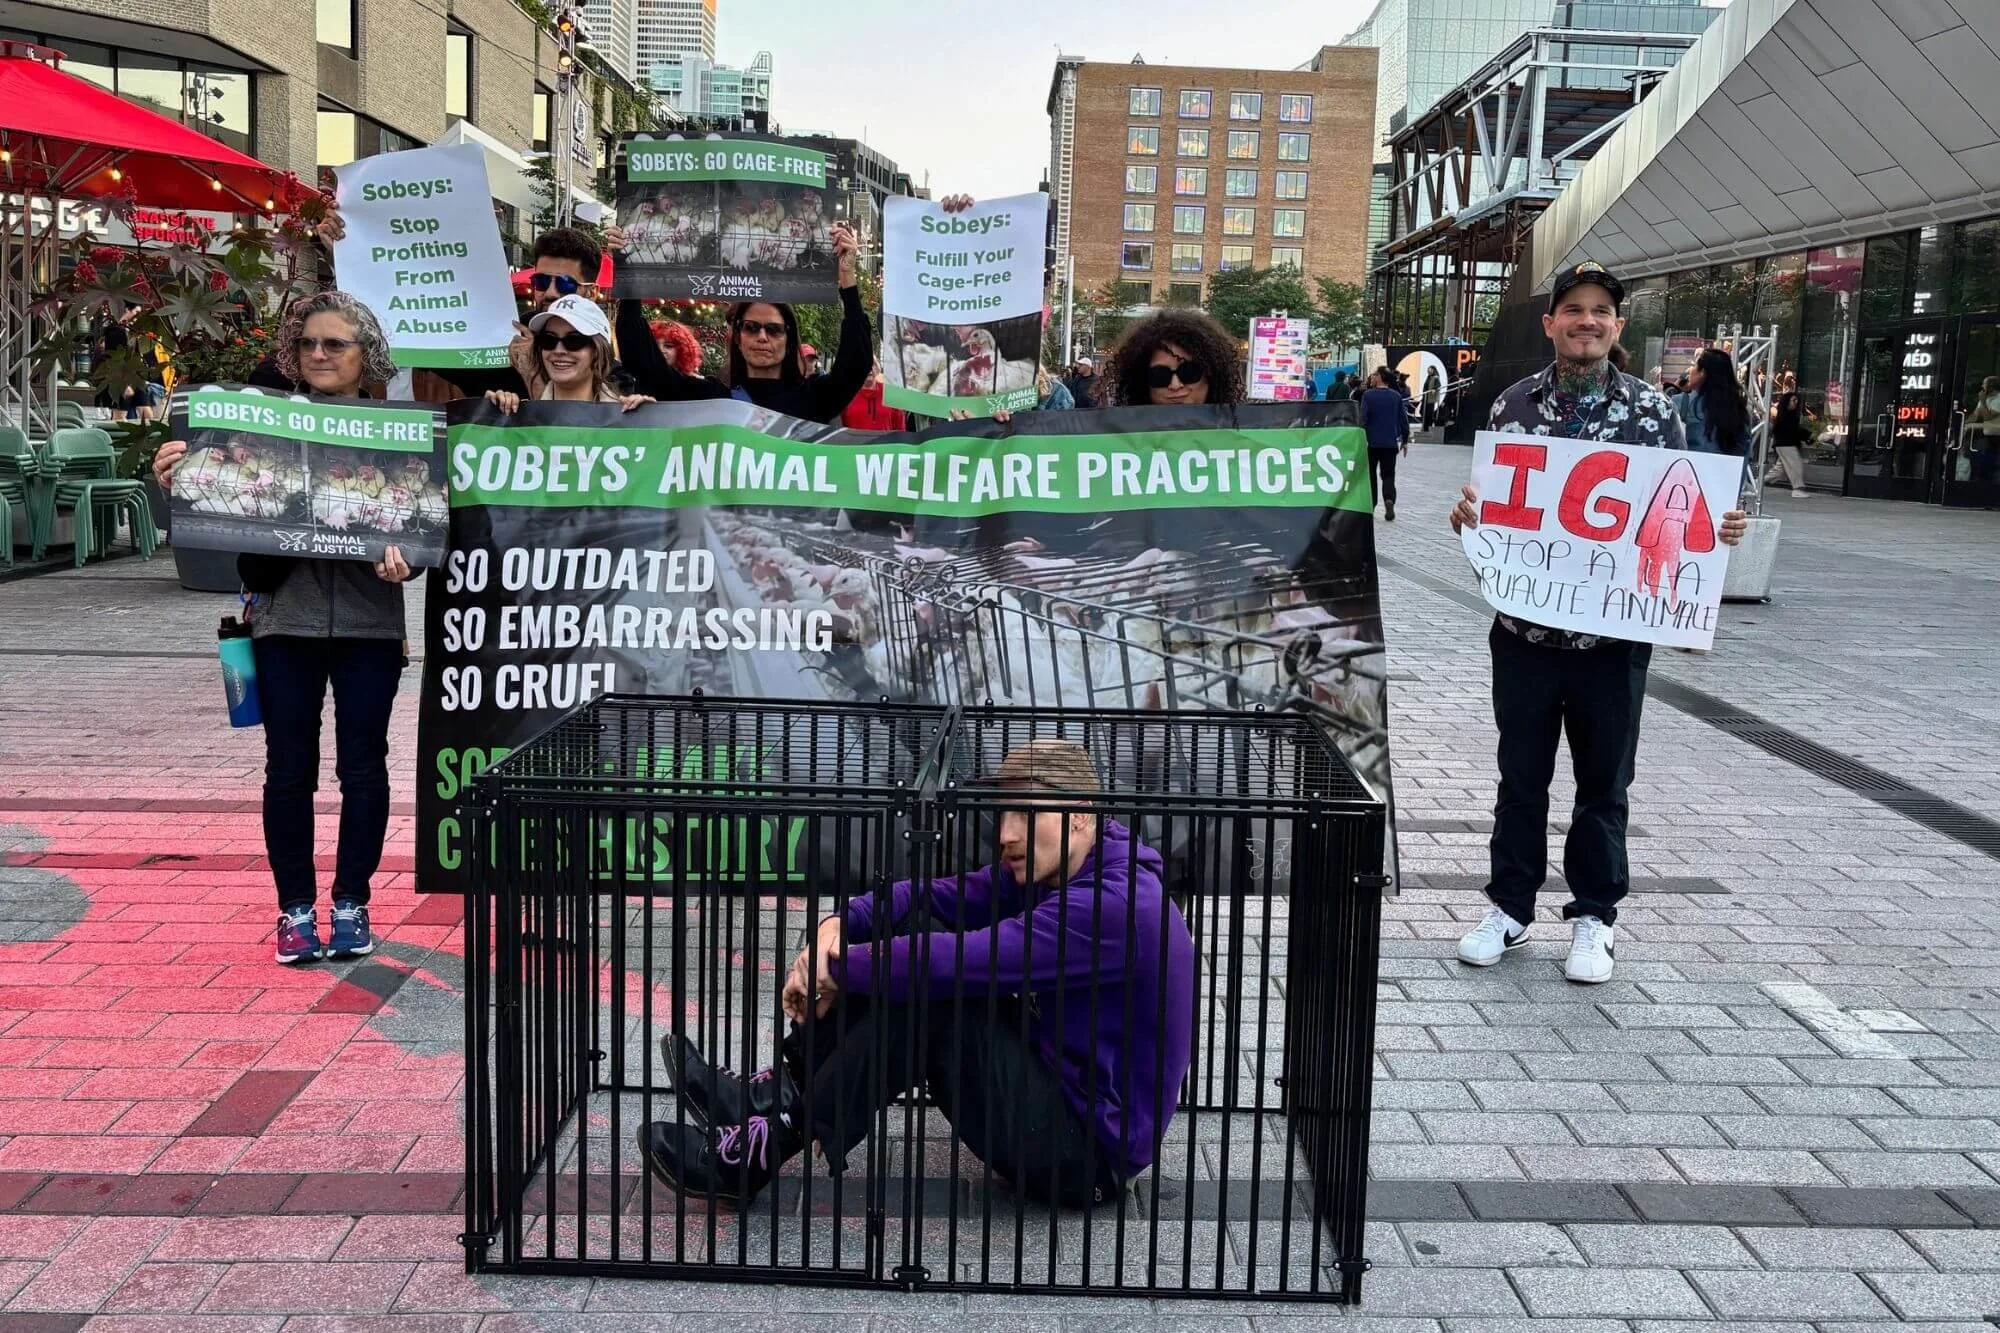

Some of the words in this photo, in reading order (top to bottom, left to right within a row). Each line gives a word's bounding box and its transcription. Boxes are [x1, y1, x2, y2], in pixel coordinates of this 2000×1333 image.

[631, 152, 699, 172] SOBEYS:
[704, 151, 727, 171] GO
[733, 153, 822, 179] CAGE-FREE
[362, 178, 453, 201] Sobeys:
[390, 217, 440, 235] Stop
[920, 213, 1011, 235] Sobeys:
[372, 240, 468, 263] Profiting
[915, 250, 968, 267] Fulfill
[974, 247, 1015, 265] Your
[395, 268, 455, 286] From
[718, 275, 762, 286] ANIMAL
[917, 270, 1012, 291] Cage-Free
[388, 291, 468, 311] Animal
[717, 286, 762, 297] JUSTICE
[927, 295, 1002, 312] Promise
[395, 319, 467, 334] Abuse
[1007, 395, 1037, 410] JUSTICE
[1008, 387, 1036, 402] ANIMAL
[194, 401, 282, 426] SOBEYS:
[288, 413, 316, 433] GO
[323, 416, 429, 442] CAGE-FREE
[658, 441, 837, 495] ANIMAL
[855, 451, 1061, 503] WELFARE
[1078, 444, 1355, 499] PRACTICES:
[1480, 443, 1716, 553] IGA
[311, 543, 366, 556] JUSTICE
[312, 533, 365, 546] ANIMAL
[446, 549, 489, 594] SO
[501, 548, 715, 593] OUTDATED
[1644, 556, 1707, 596] LA
[1600, 583, 1720, 632] ANIMALE
[442, 607, 486, 652] SO
[499, 604, 833, 653] EMBARRASSING
[441, 665, 483, 711] SO
